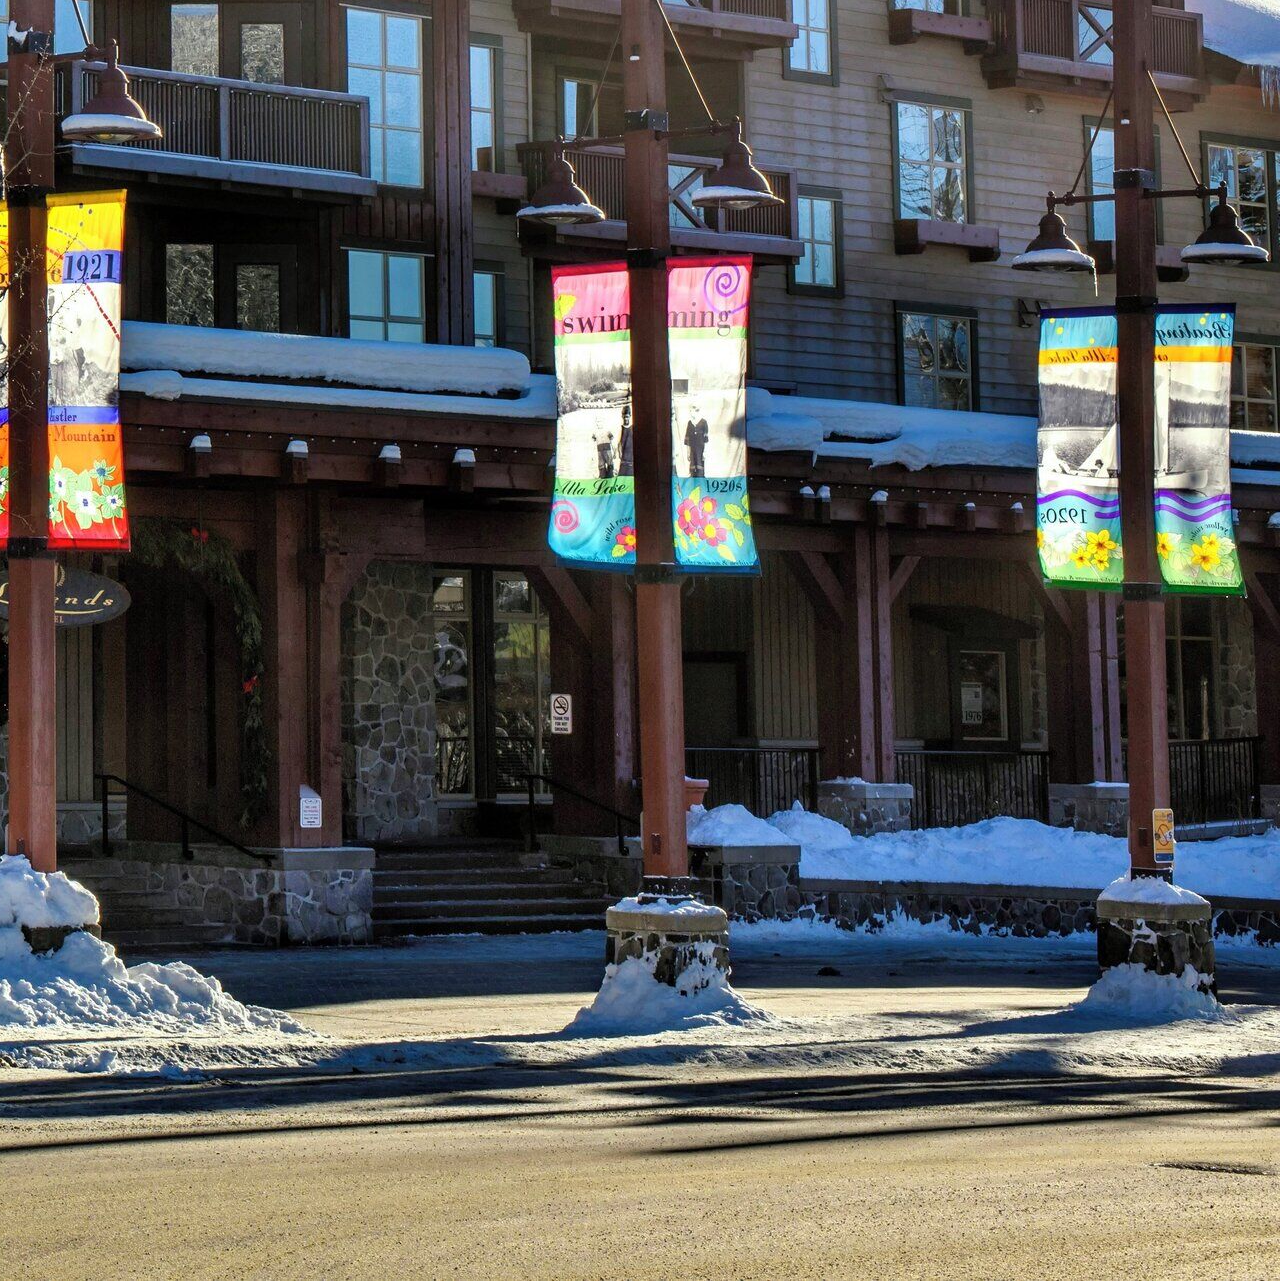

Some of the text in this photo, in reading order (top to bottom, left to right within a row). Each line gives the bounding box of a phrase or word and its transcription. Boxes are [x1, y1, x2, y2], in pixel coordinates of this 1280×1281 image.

[63, 253, 117, 281] 1921
[48, 408, 78, 422] histler
[54, 425, 116, 442] Mountain
[705, 479, 743, 493] 1920s
